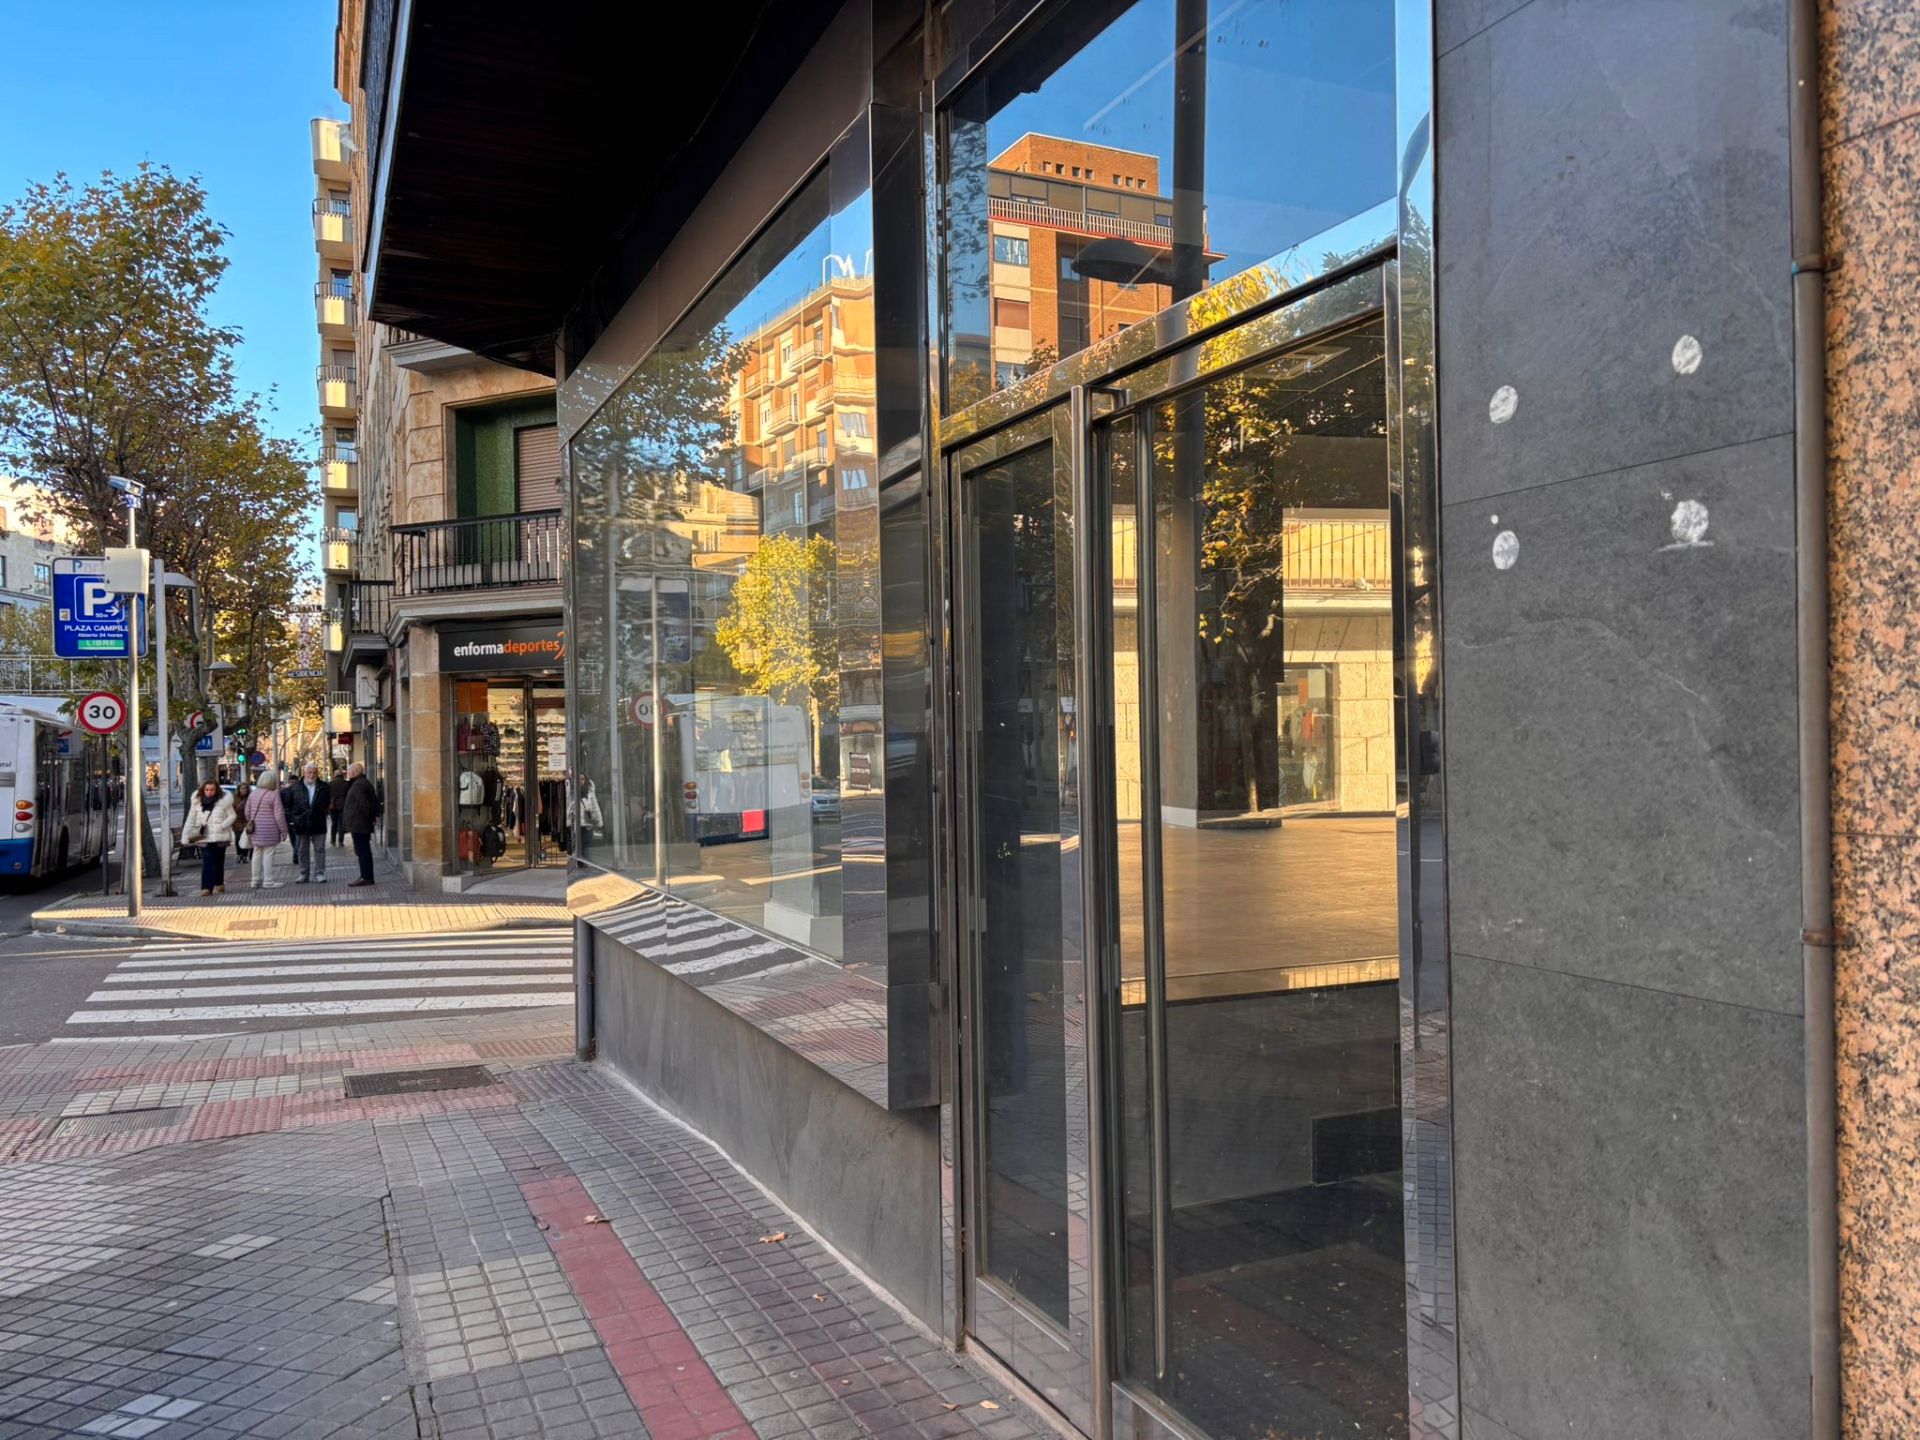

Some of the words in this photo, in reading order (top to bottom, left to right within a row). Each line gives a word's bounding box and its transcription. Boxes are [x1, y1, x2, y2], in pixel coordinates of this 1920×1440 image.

[83, 582, 115, 617] P
[64, 624, 92, 632] PLAZA
[93, 624, 129, 632] CAMPILL
[453, 640, 560, 657] enformadeportes
[89, 704, 116, 720] 30
